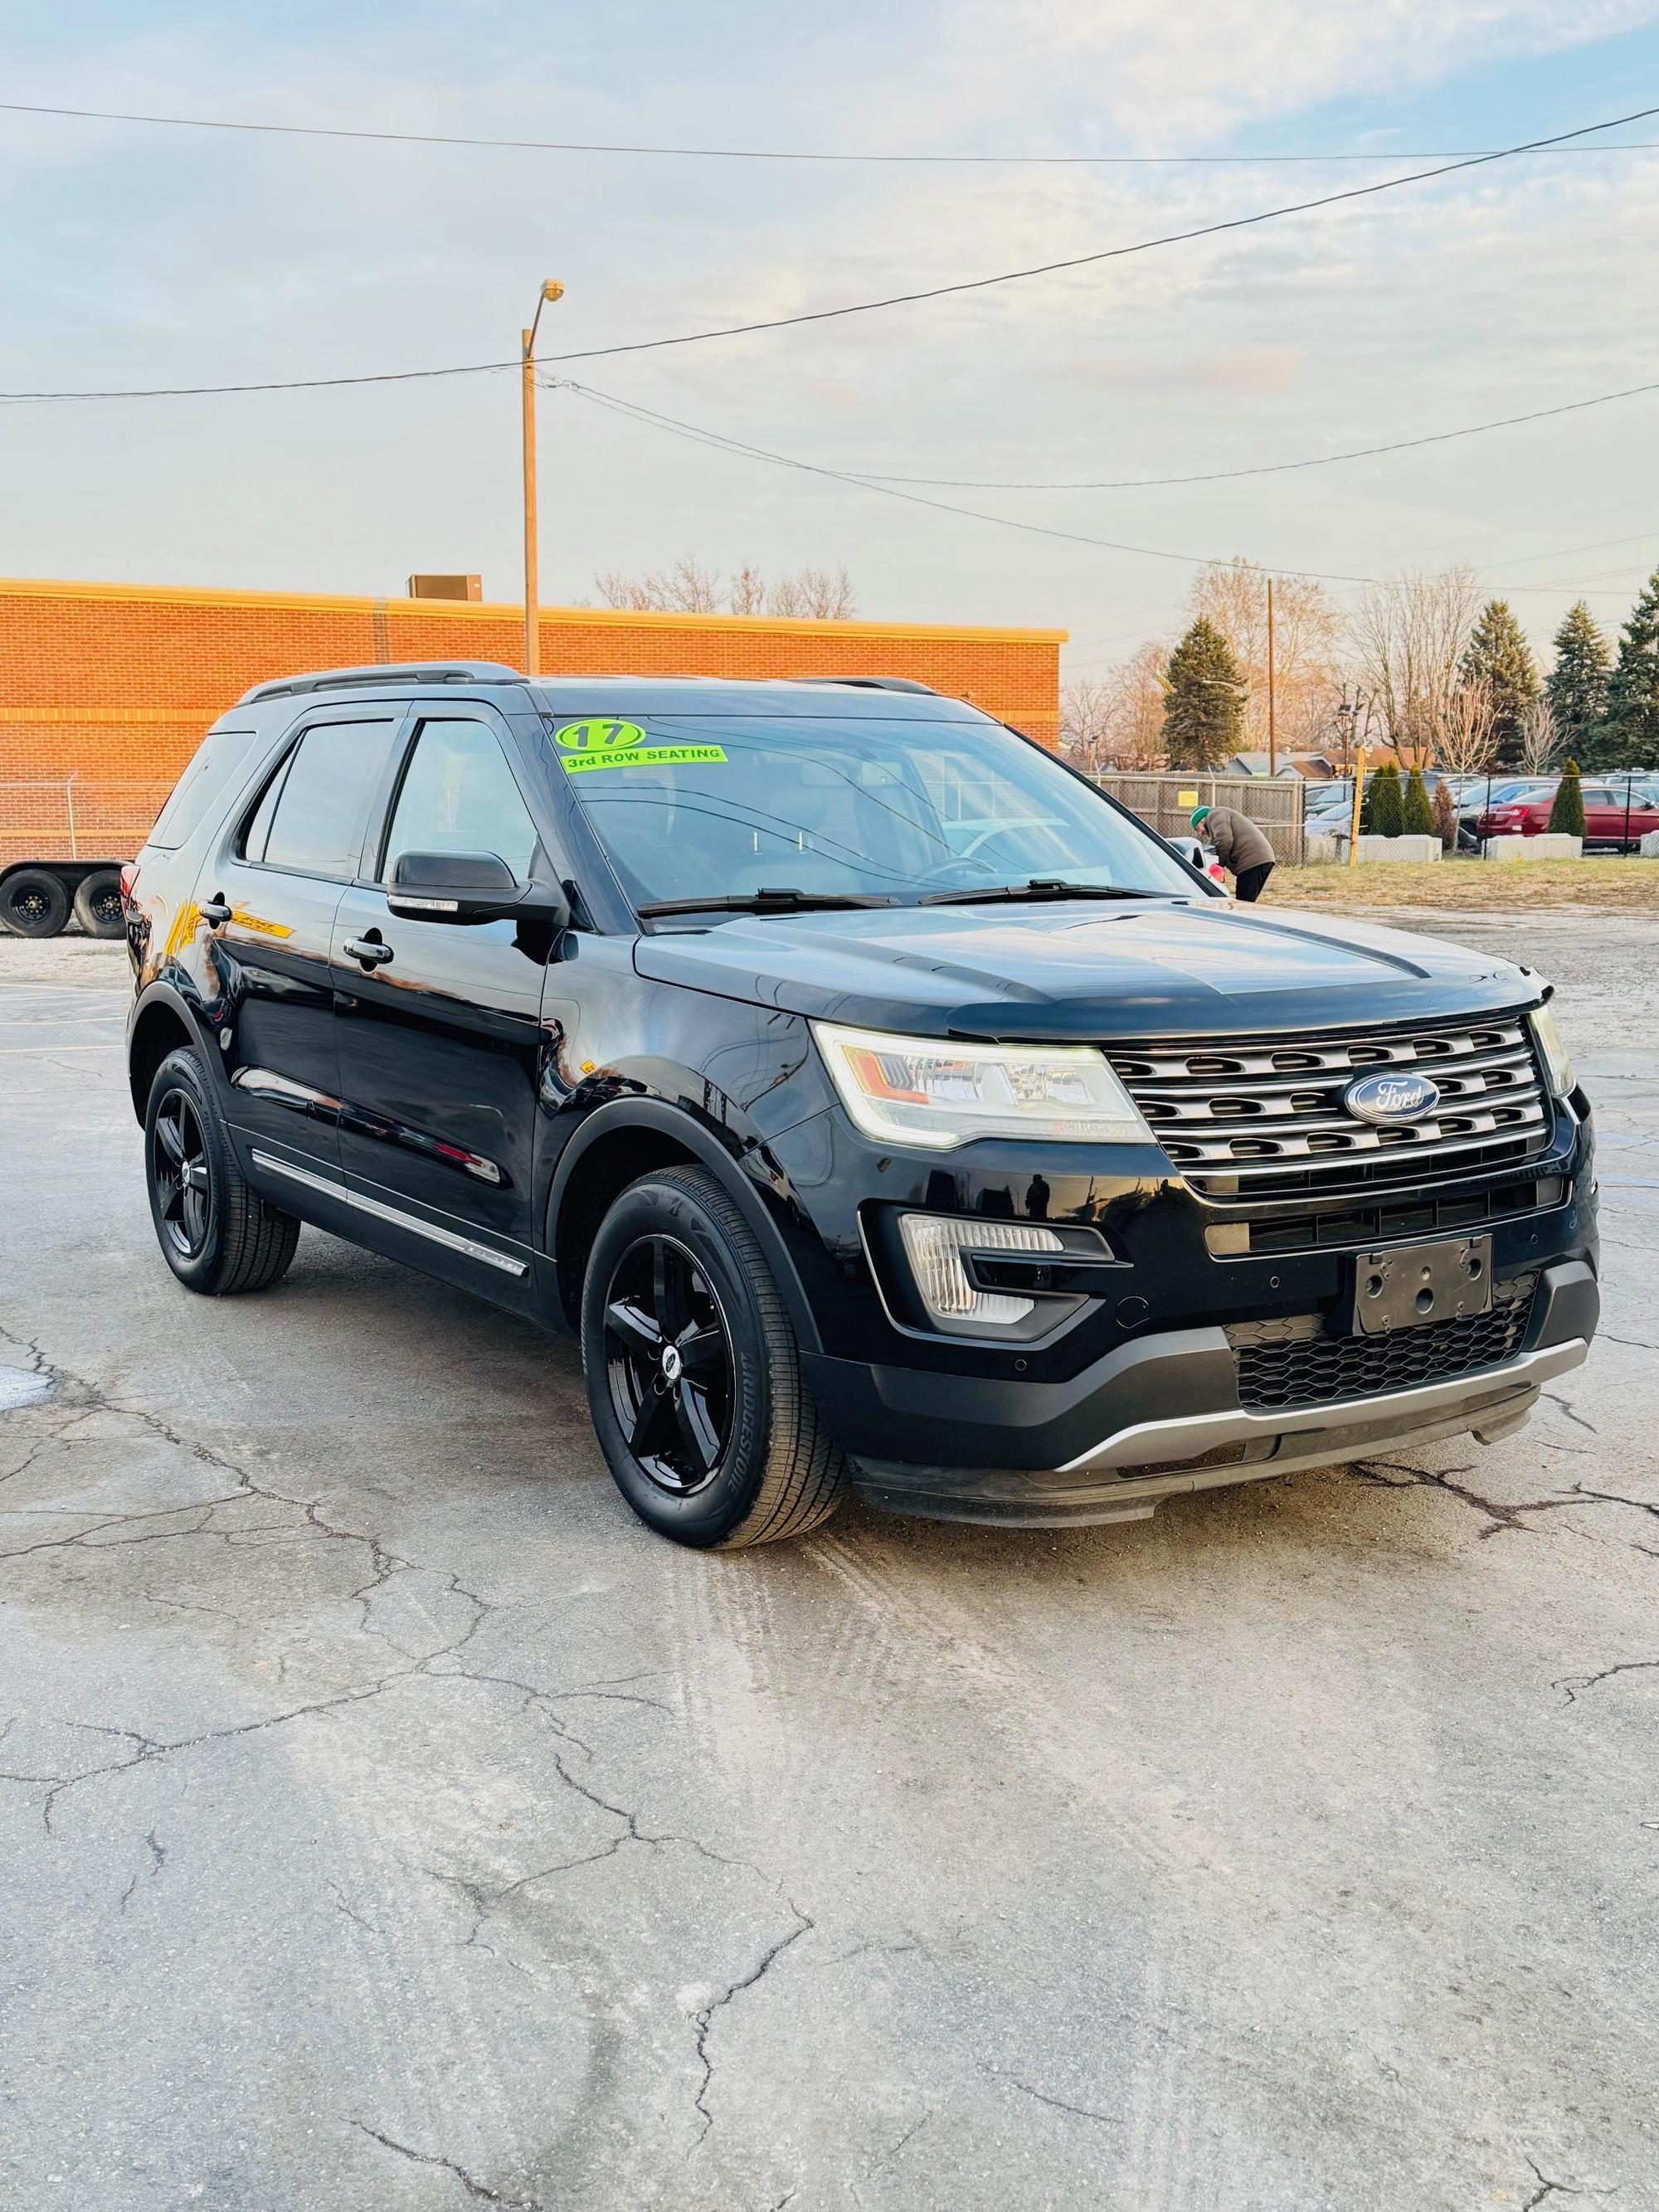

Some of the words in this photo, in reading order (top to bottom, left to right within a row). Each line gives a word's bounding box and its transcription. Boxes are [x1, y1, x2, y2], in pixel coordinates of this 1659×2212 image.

[572, 723, 624, 748] 17
[567, 756, 596, 768] 3rd
[601, 752, 639, 764] ROW
[646, 749, 720, 760] SEATING
[1375, 1081, 1424, 1111] Ford
